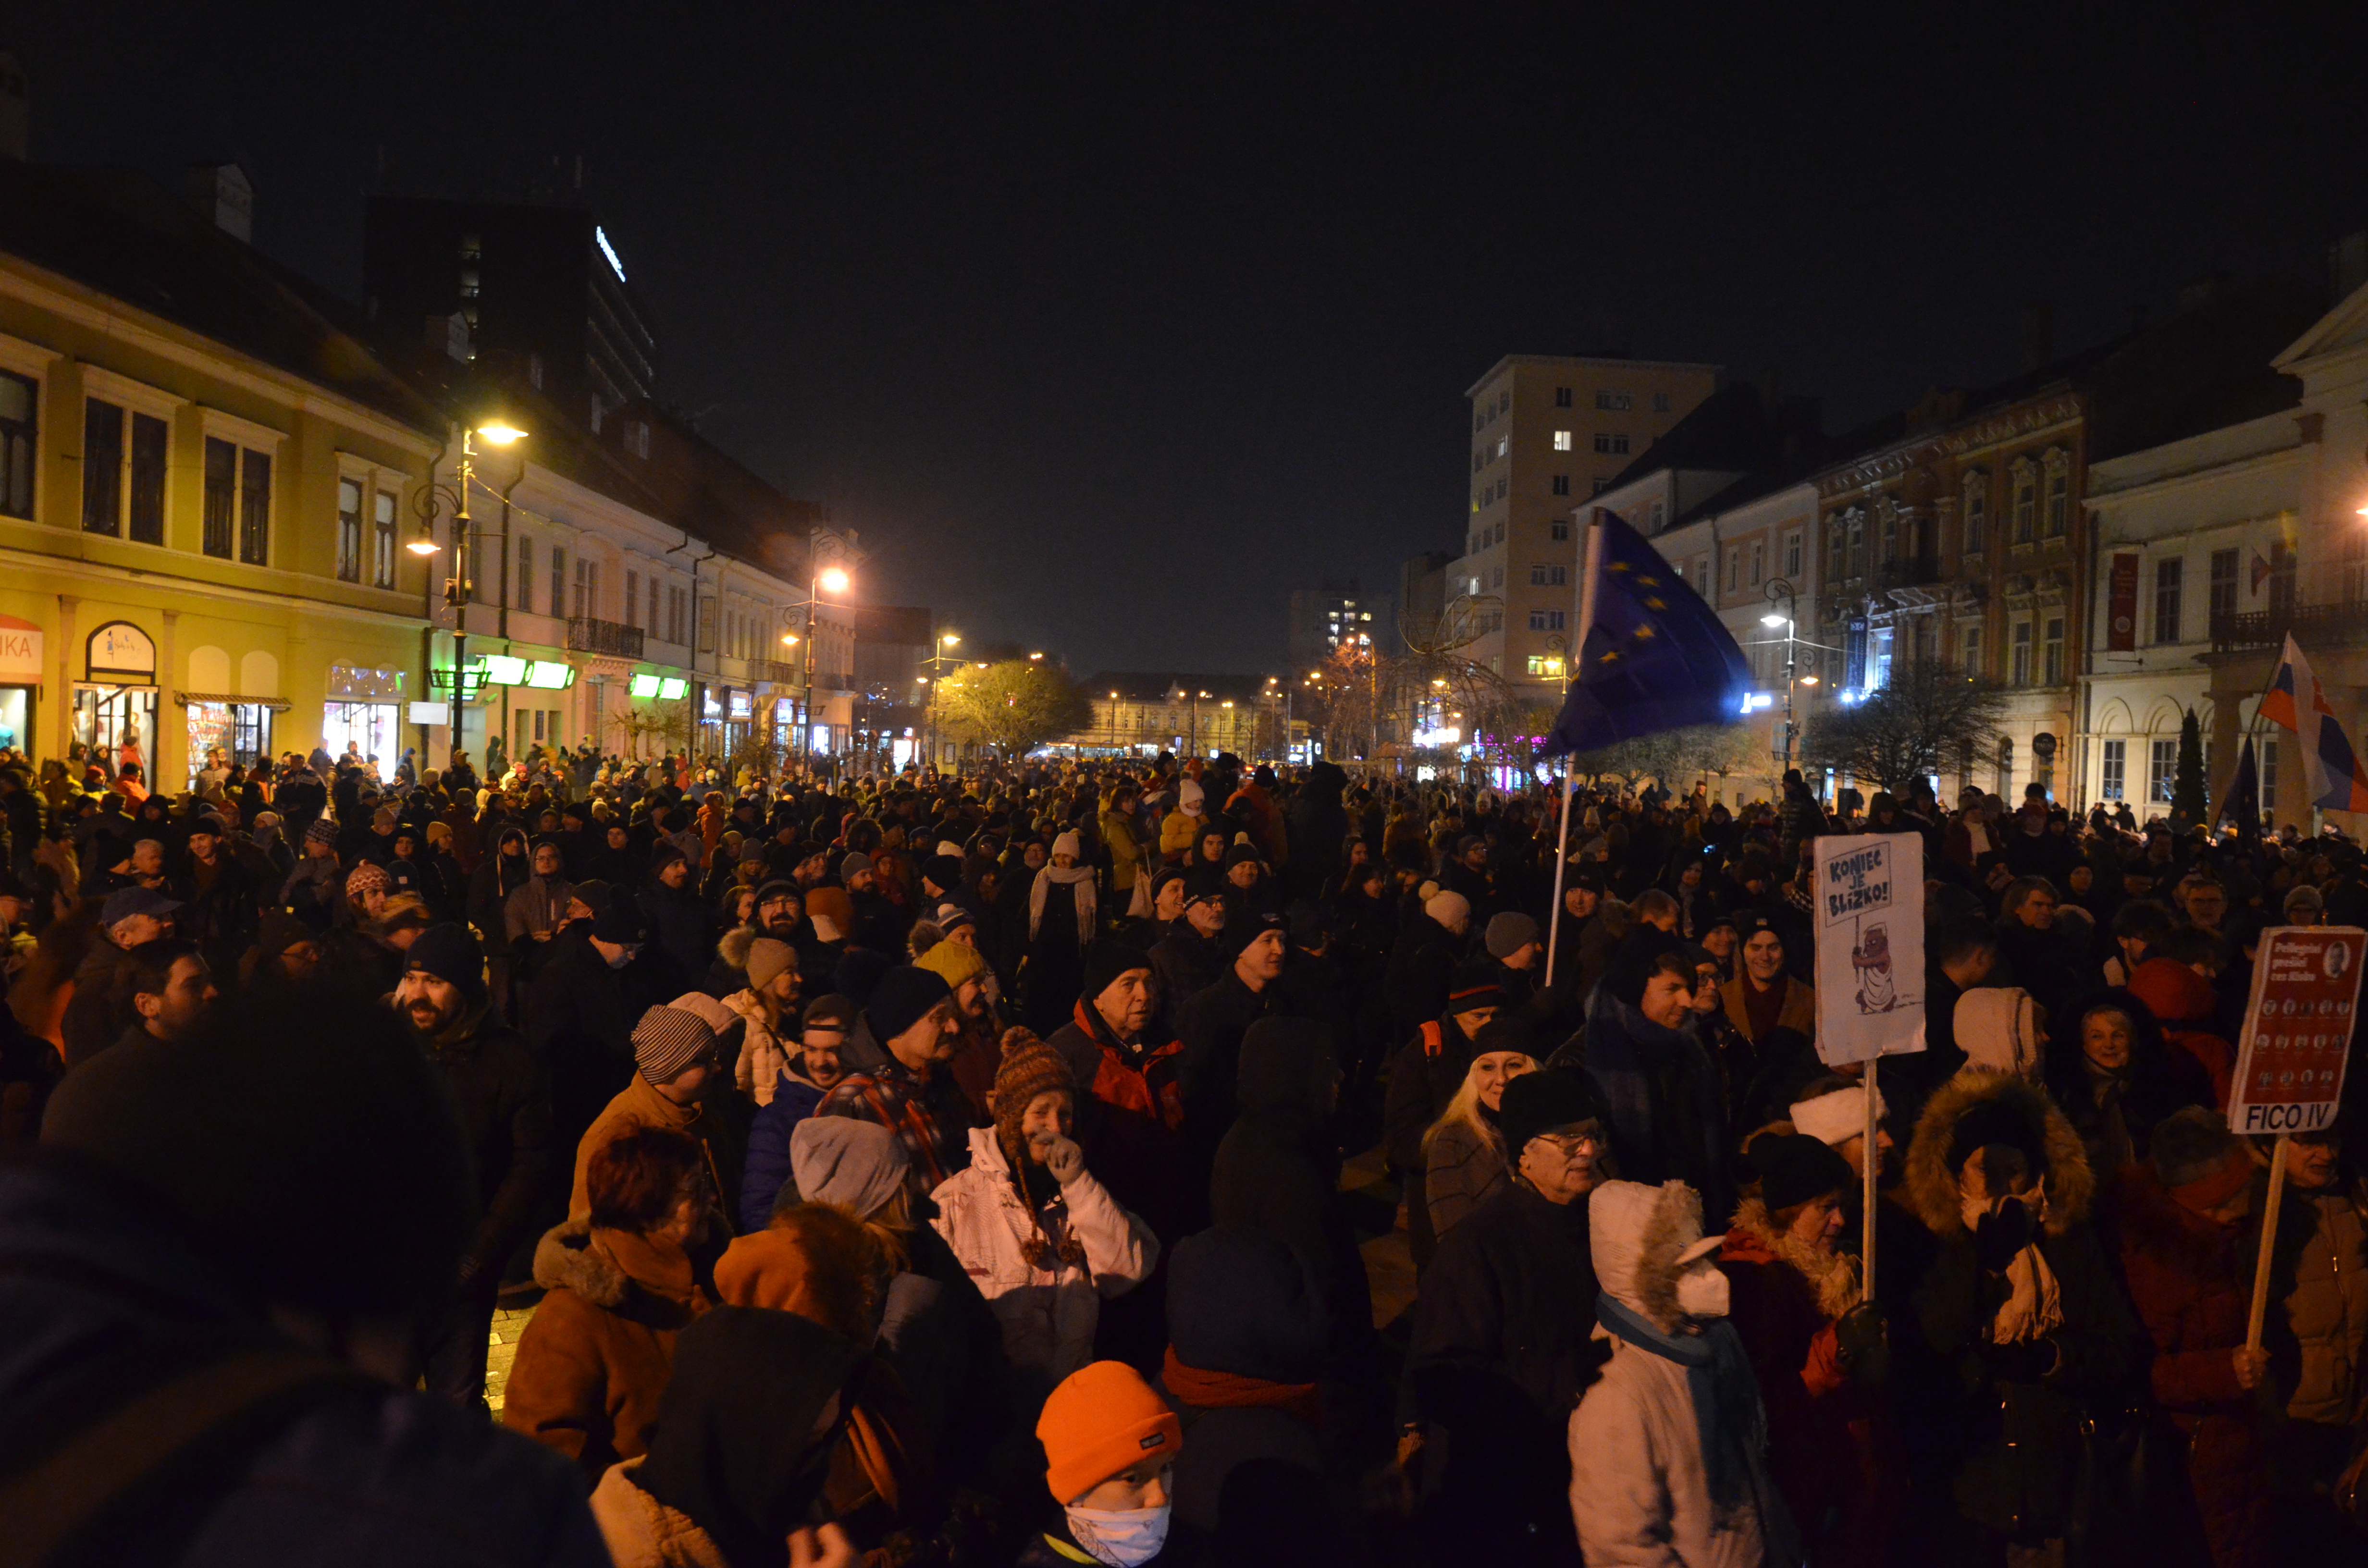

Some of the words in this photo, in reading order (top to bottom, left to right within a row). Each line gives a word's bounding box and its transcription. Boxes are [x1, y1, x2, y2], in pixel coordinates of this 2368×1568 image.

[0, 635, 31, 658] KA
[1830, 849, 1882, 883] KONIEC
[1849, 873, 1865, 889] JE
[2246, 1104, 2301, 1129] FICO
[2307, 1103, 2330, 1127] IV
